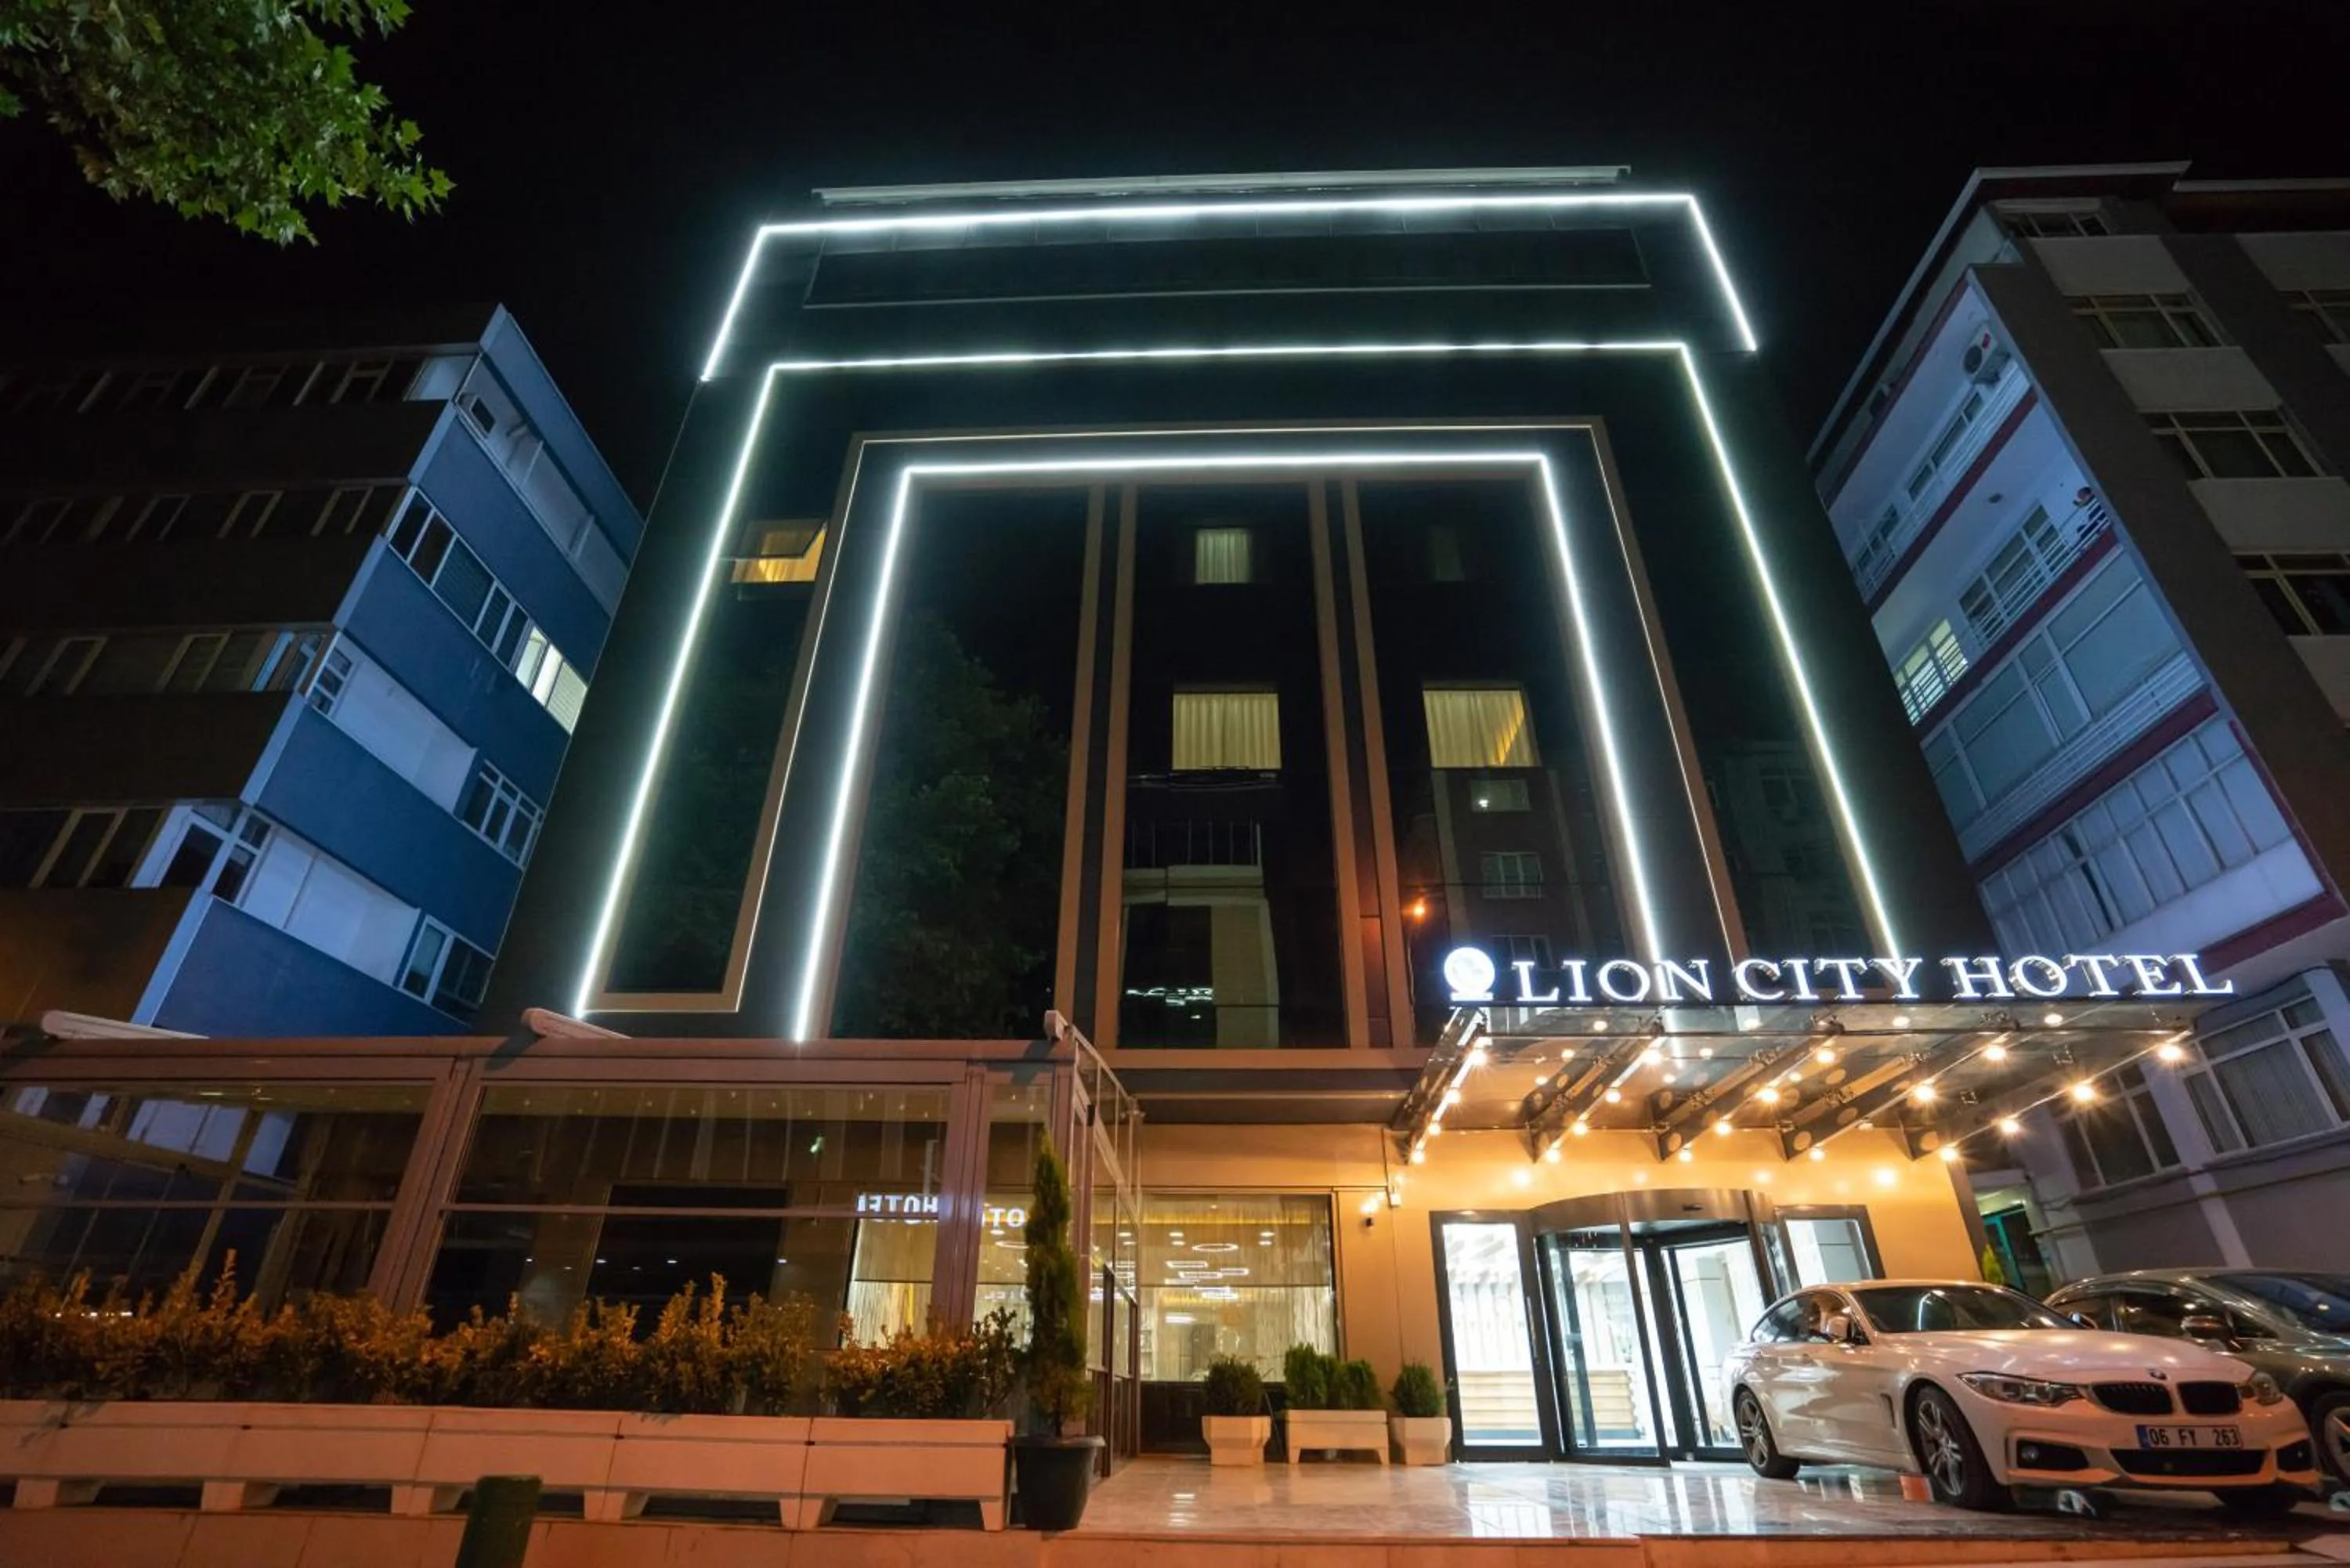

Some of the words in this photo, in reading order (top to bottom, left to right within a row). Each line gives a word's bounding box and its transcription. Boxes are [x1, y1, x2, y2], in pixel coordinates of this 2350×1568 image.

[1511, 959, 1713, 1002] LION
[1733, 957, 1922, 1000] CITY
[1940, 952, 2234, 998] HOTEL
[2149, 1429, 2170, 1446] 06
